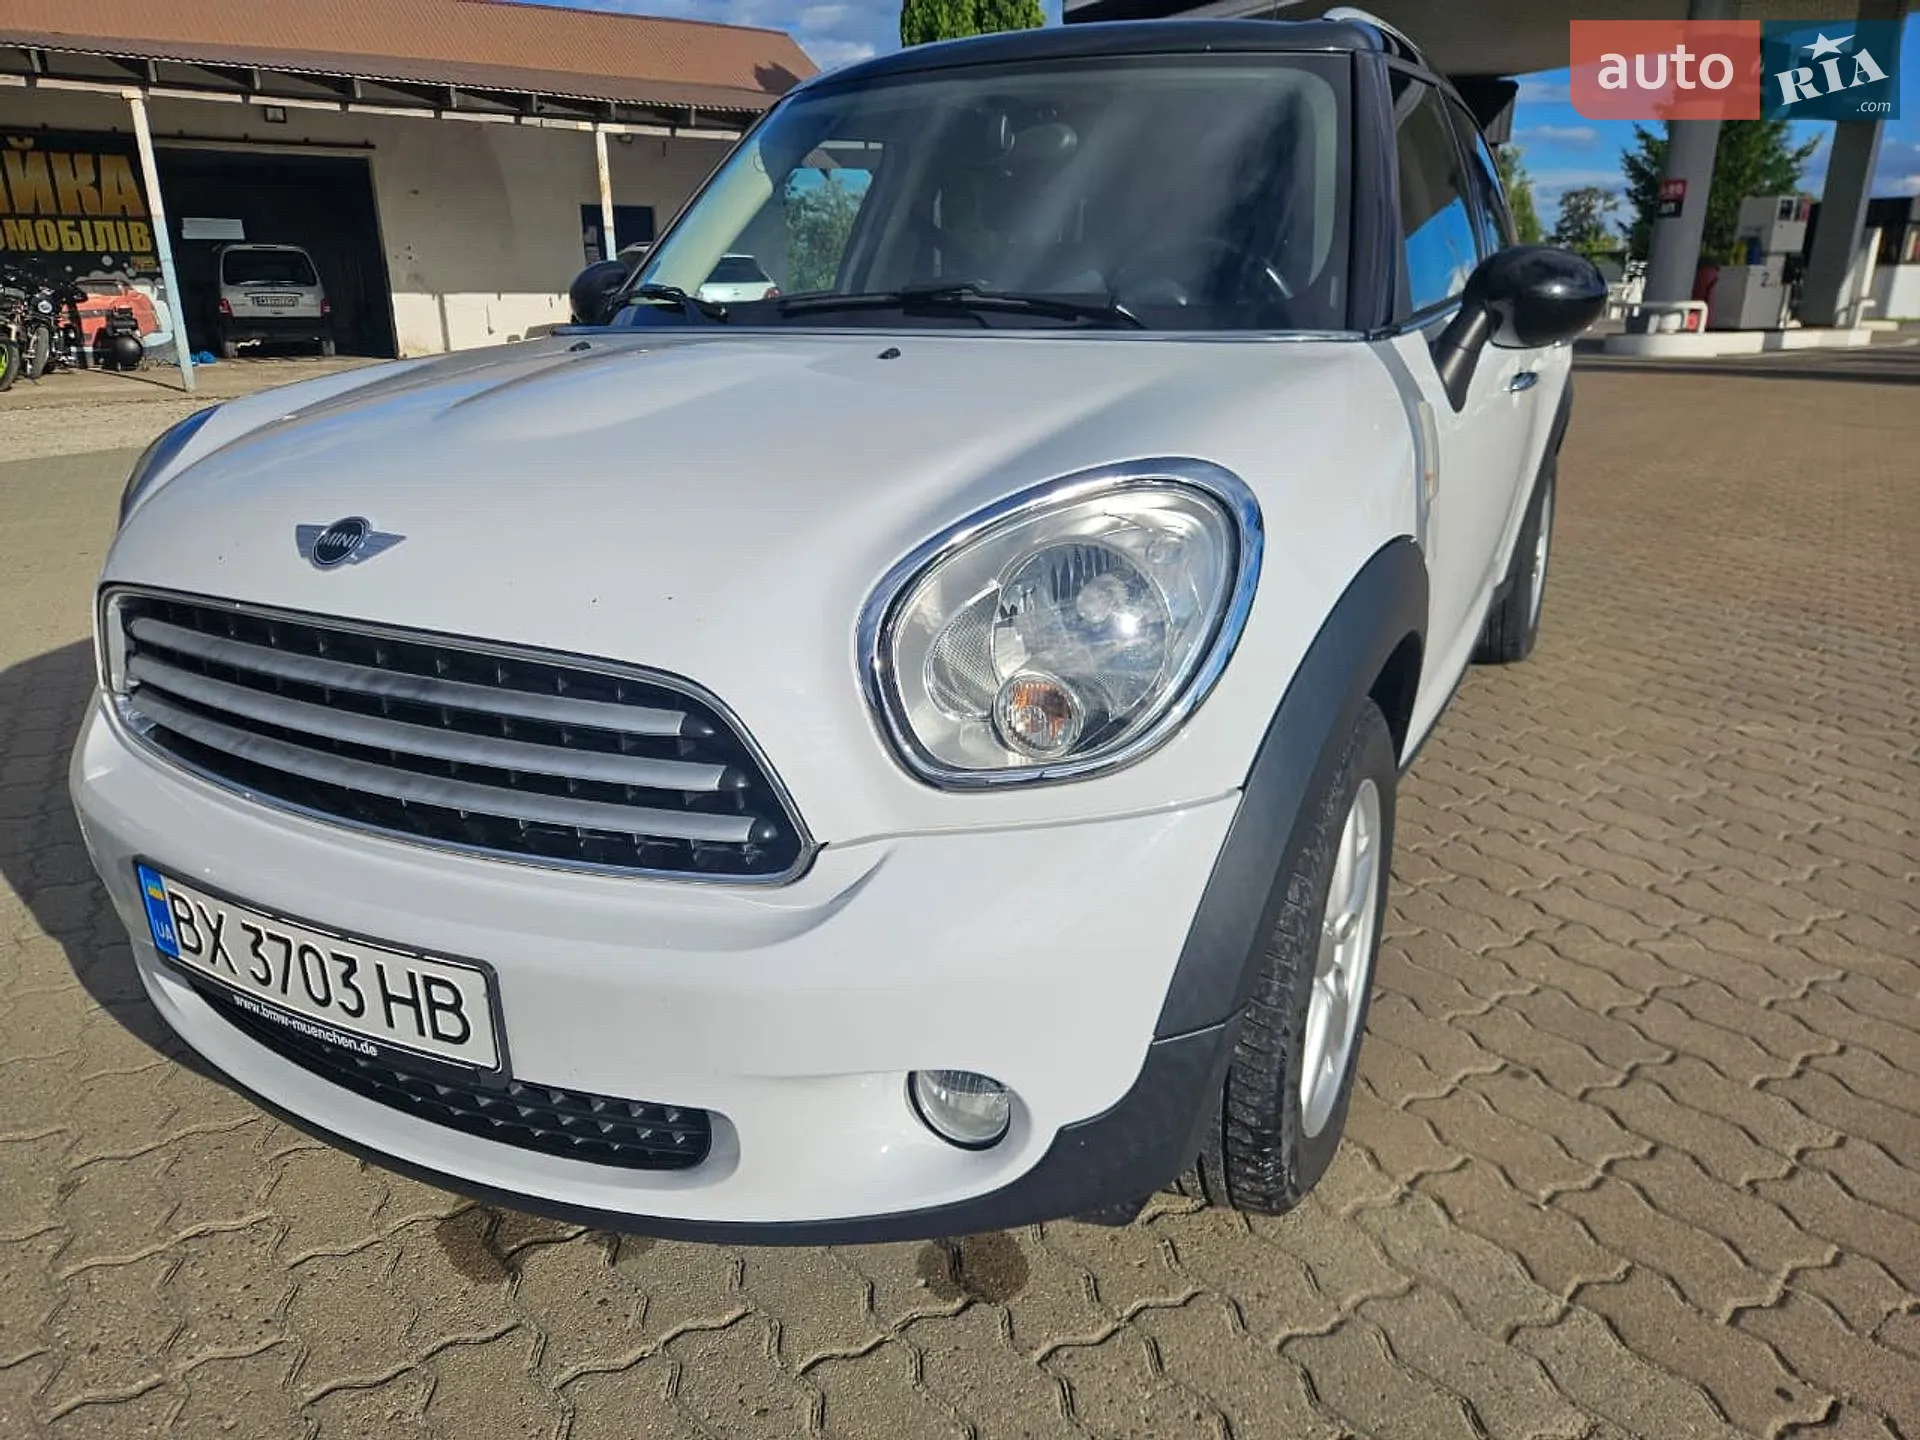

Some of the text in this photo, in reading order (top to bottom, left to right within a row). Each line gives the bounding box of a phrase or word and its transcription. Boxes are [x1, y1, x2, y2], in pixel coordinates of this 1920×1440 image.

[0, 136, 146, 216] ЙКА
[0, 218, 153, 252] МОБІЛІВ
[153, 919, 175, 945] UA
[167, 889, 471, 1046] BX 3703 HB
[232, 994, 378, 1057] www.bmw-muenchen.de
